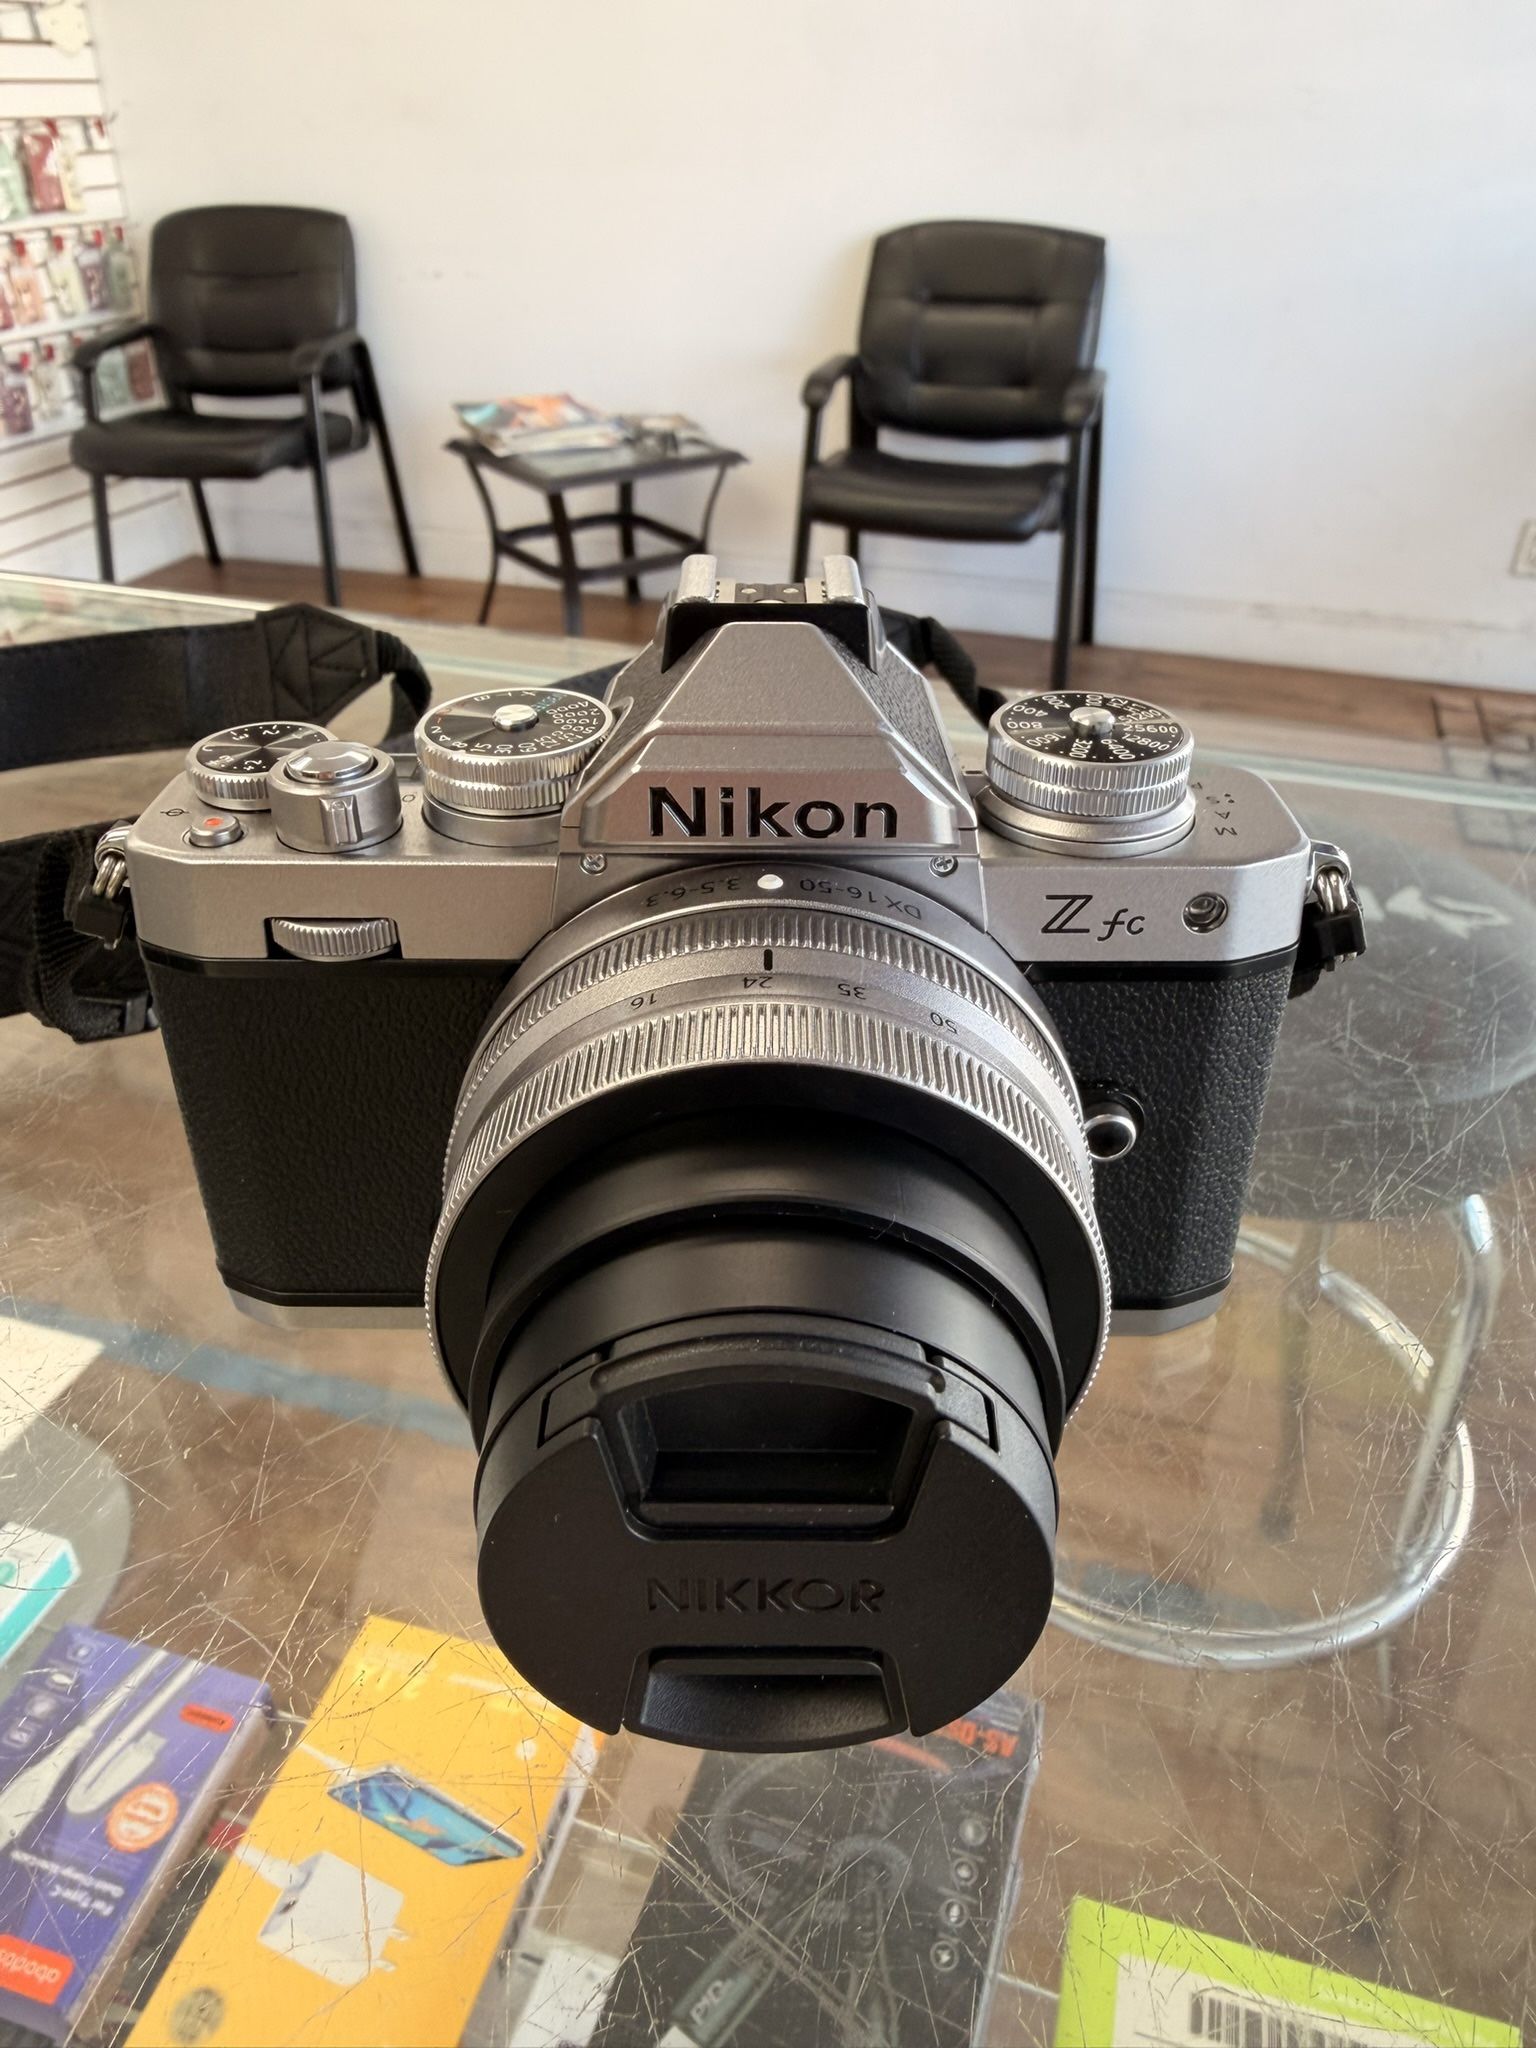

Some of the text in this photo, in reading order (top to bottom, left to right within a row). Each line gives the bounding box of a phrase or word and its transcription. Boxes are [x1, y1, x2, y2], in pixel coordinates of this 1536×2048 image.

[545, 701, 590, 715] 4000
[1012, 704, 1049, 717] 400
[561, 724, 596, 734] 500
[1006, 721, 1043, 729] 800
[1123, 724, 1179, 733] 25600
[1100, 739, 1136, 760] 6400
[1121, 732, 1171, 751] 12800
[648, 786, 898, 840] Nikon
[645, 878, 740, 908] 3.5-6.3
[1041, 894, 1146, 941] Z fc
[743, 976, 773, 990] 24
[837, 982, 867, 1000] 35
[630, 993, 657, 1009] 16
[930, 1011, 959, 1036] 50
[647, 1577, 887, 1614] NIKKOR
